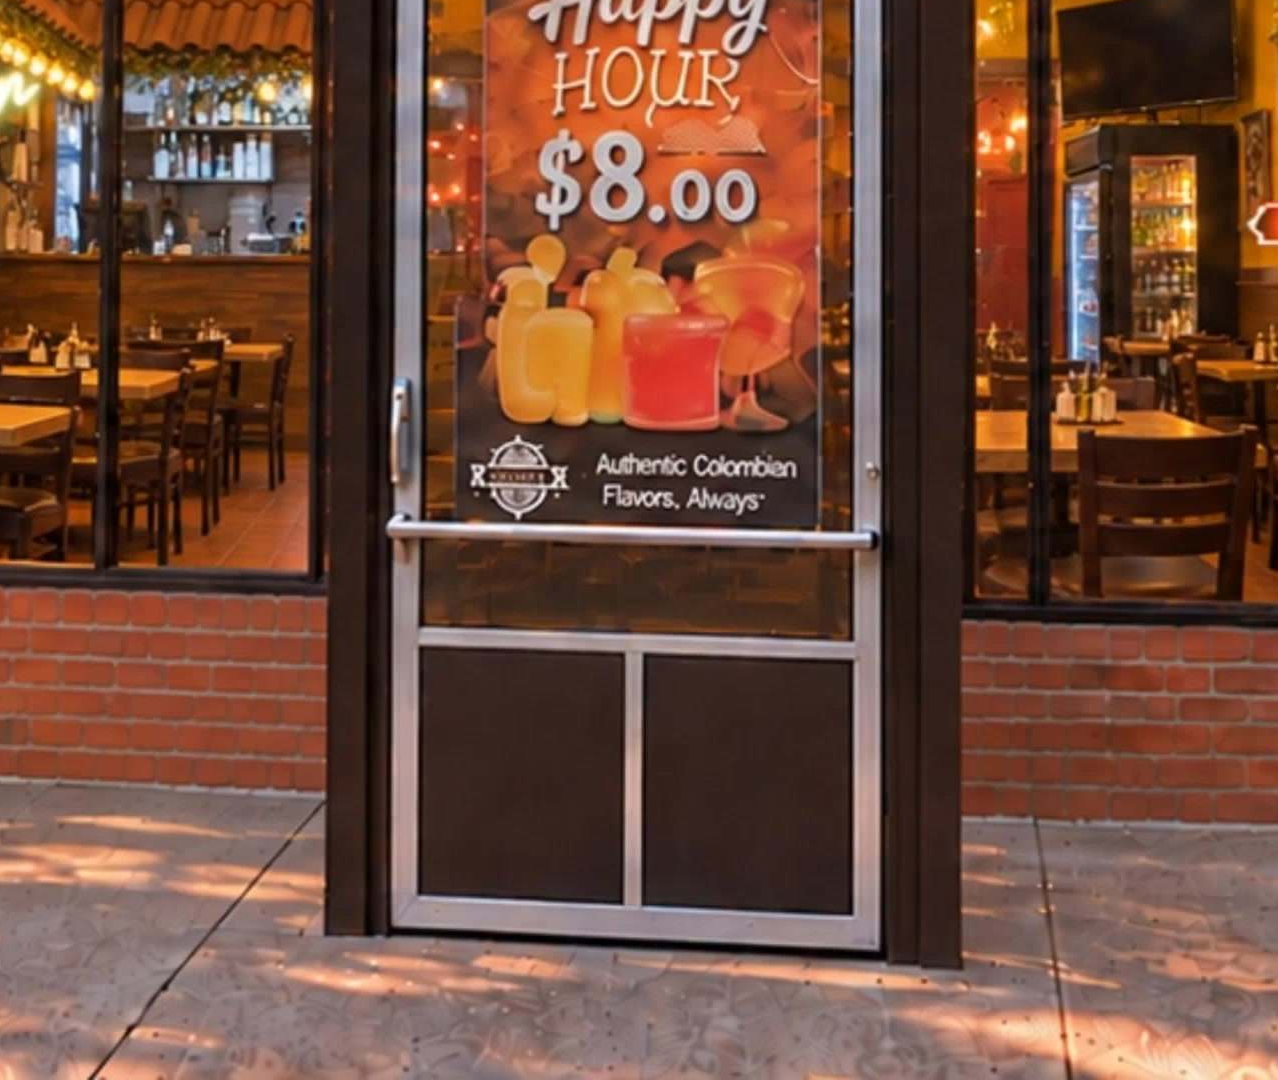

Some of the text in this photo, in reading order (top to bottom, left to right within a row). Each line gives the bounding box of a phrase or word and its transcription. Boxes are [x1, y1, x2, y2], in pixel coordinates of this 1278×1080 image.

[551, 46, 741, 128] HOUR
[534, 128, 757, 231] $8.00
[595, 452, 688, 478] Authentic
